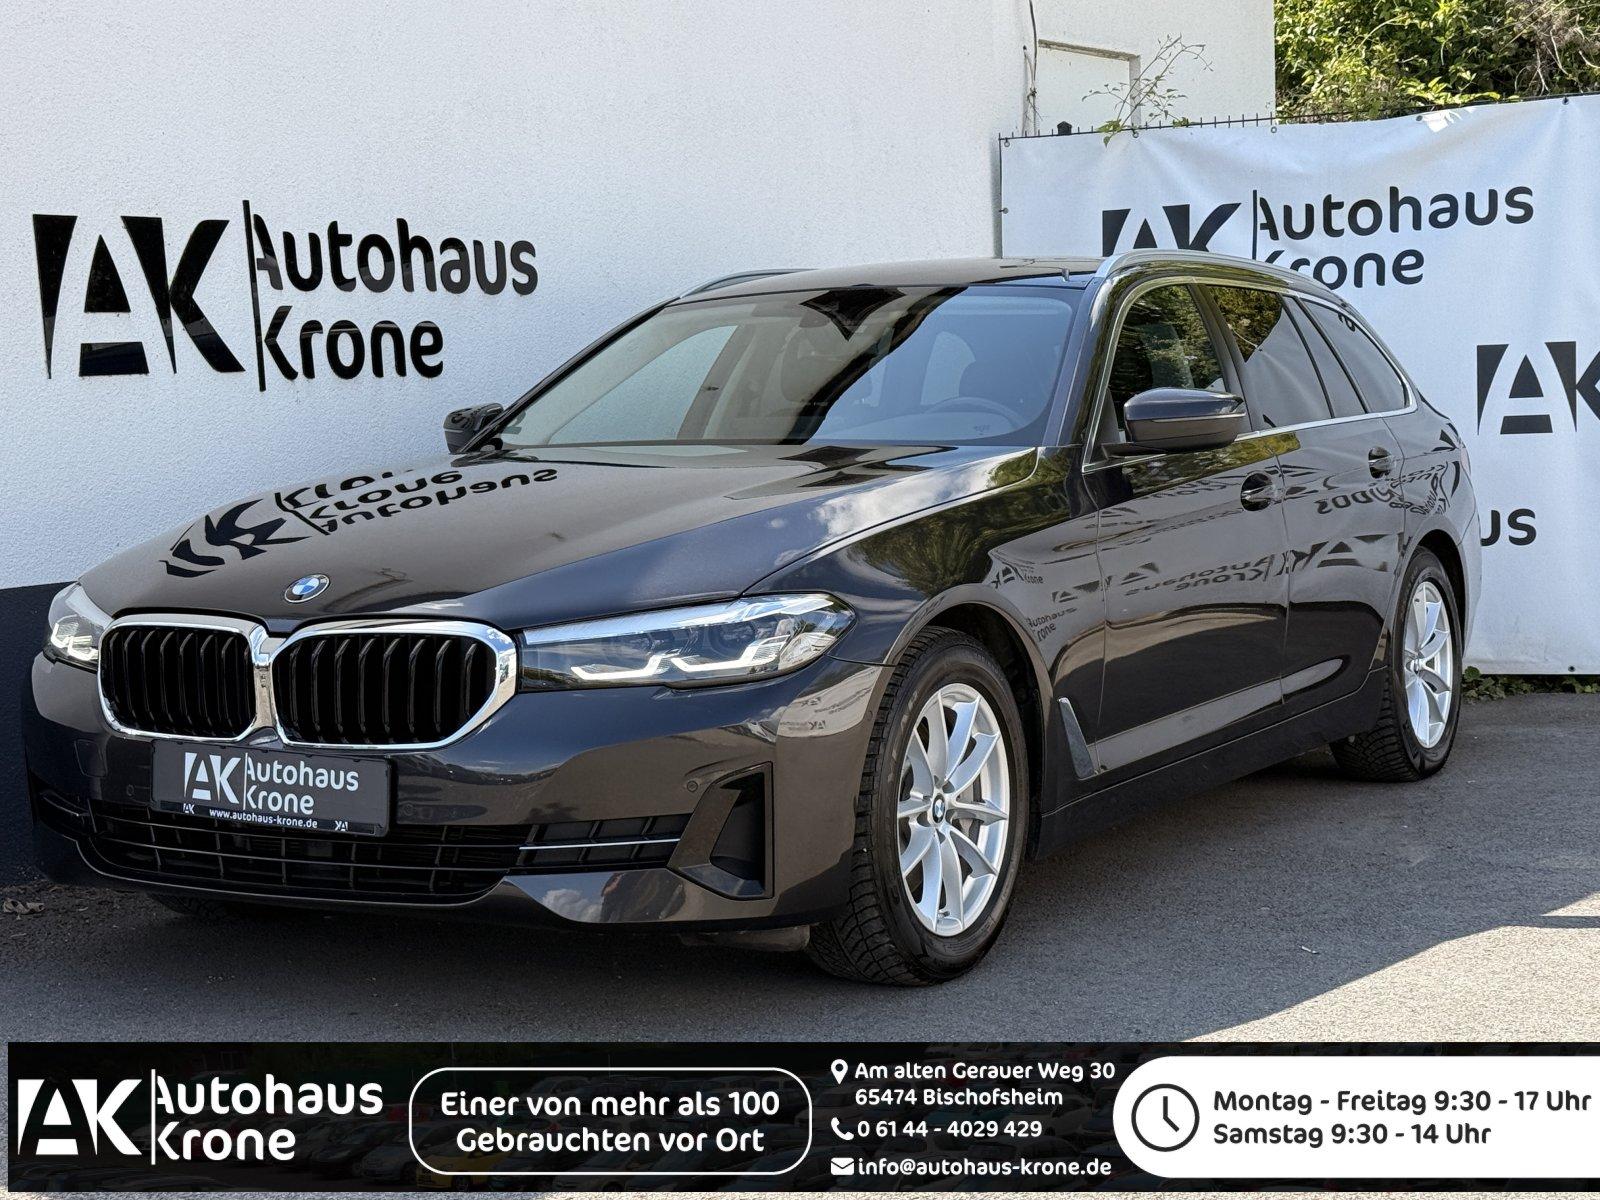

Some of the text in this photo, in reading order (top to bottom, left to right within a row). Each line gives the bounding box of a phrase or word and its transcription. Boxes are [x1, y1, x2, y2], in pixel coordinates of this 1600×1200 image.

[1259, 186, 1535, 241] Autohaus
[253, 213, 538, 296] Autohaus
[32, 213, 246, 379] AK
[263, 304, 445, 381] Krone
[184, 752, 242, 804] AK
[246, 785, 315, 815] Krone
[247, 757, 359, 792] Autohaus
[209, 808, 318, 829] www.autohaus-krone.de
